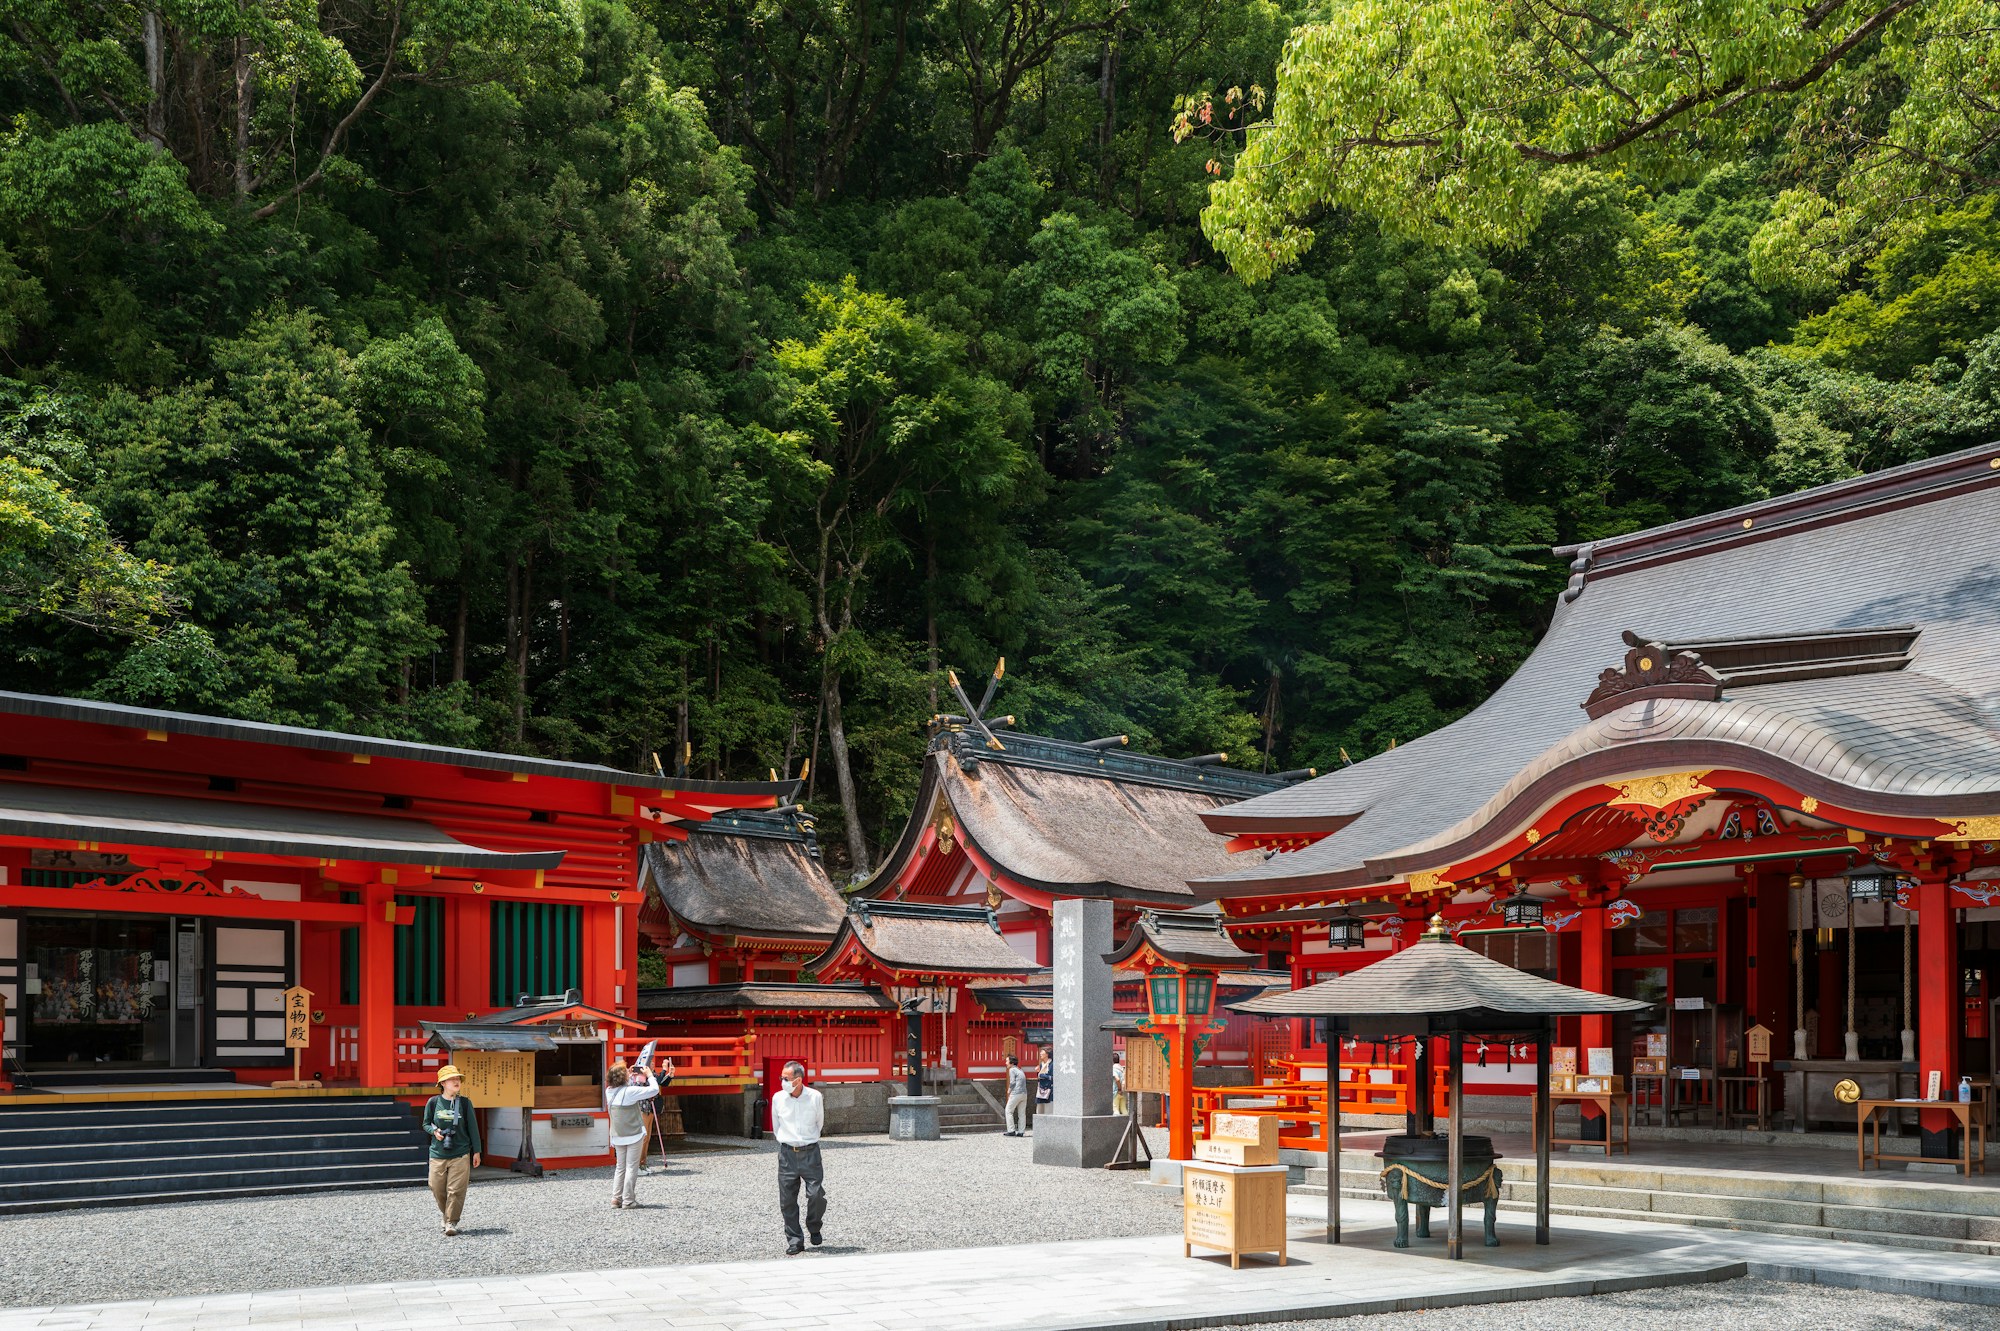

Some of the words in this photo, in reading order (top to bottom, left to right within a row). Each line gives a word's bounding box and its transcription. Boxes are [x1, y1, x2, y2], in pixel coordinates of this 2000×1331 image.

[1059, 916, 1077, 1074] 熊野那智大社
[290, 993, 307, 1042] 宝物殿
[560, 1117, 591, 1126] おこころざし
[1192, 1177, 1226, 1194] 祈願護摩木
[1195, 1193, 1223, 1208] 焚き上げ
